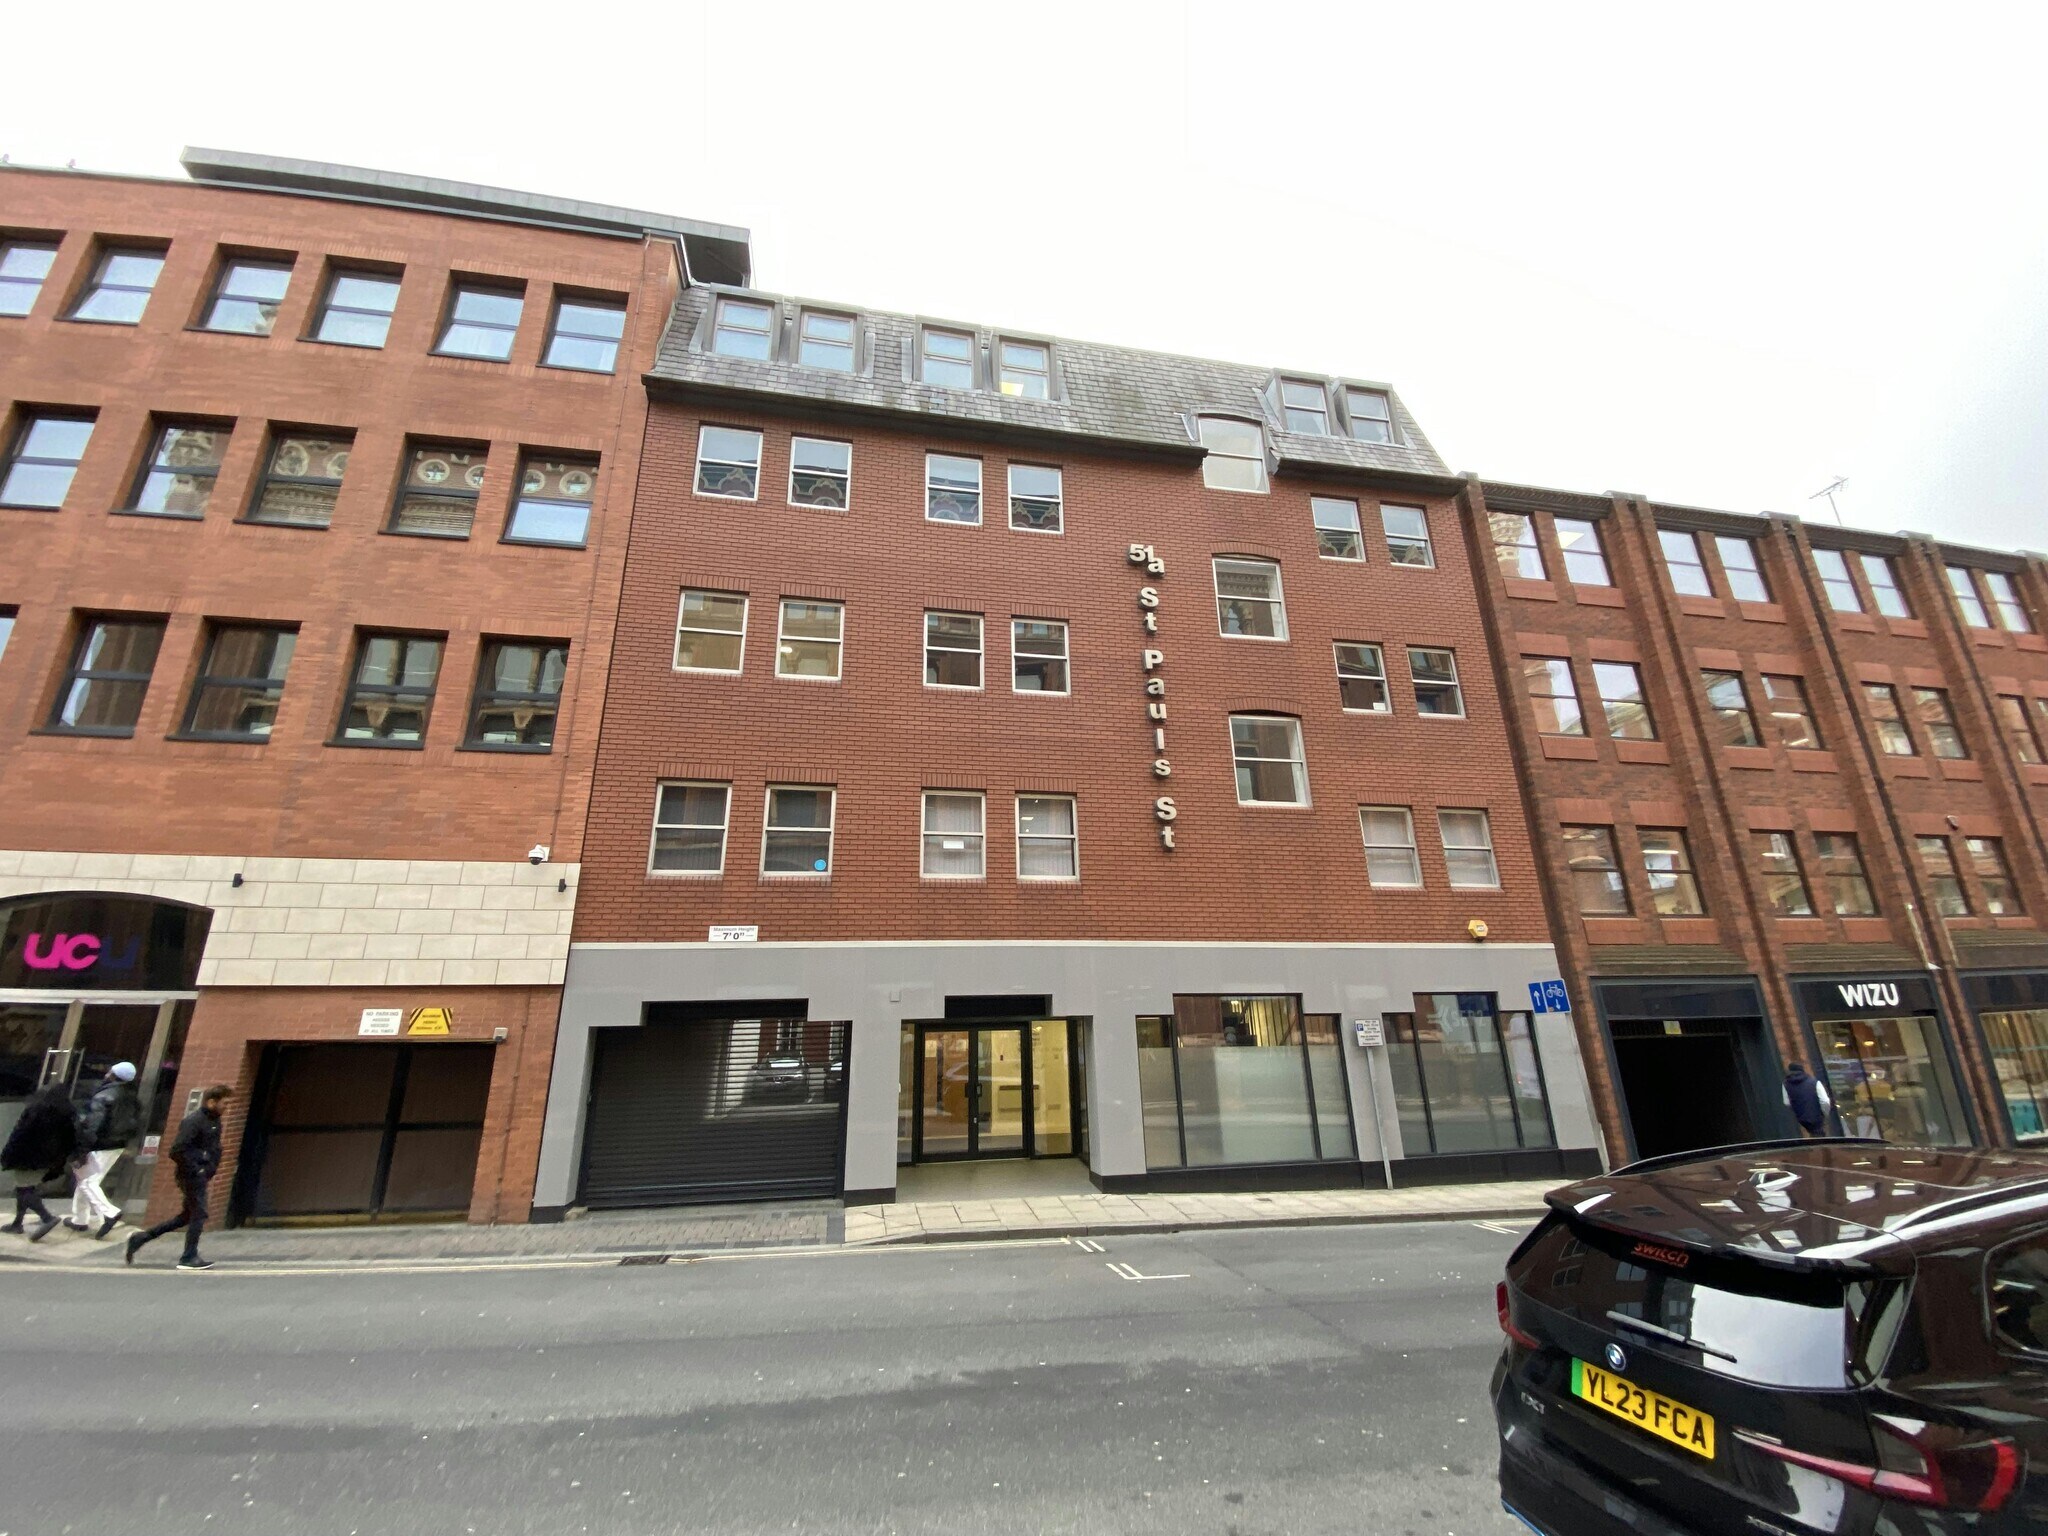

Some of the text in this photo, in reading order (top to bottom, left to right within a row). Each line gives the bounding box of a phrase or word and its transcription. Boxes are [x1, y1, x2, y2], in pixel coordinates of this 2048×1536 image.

[1128, 543, 1177, 848] 51a St Pauls St
[1838, 982, 1900, 1008] WIZU
[1633, 1243, 1690, 1265] switch
[1586, 1368, 1707, 1450] YL23 FCA
